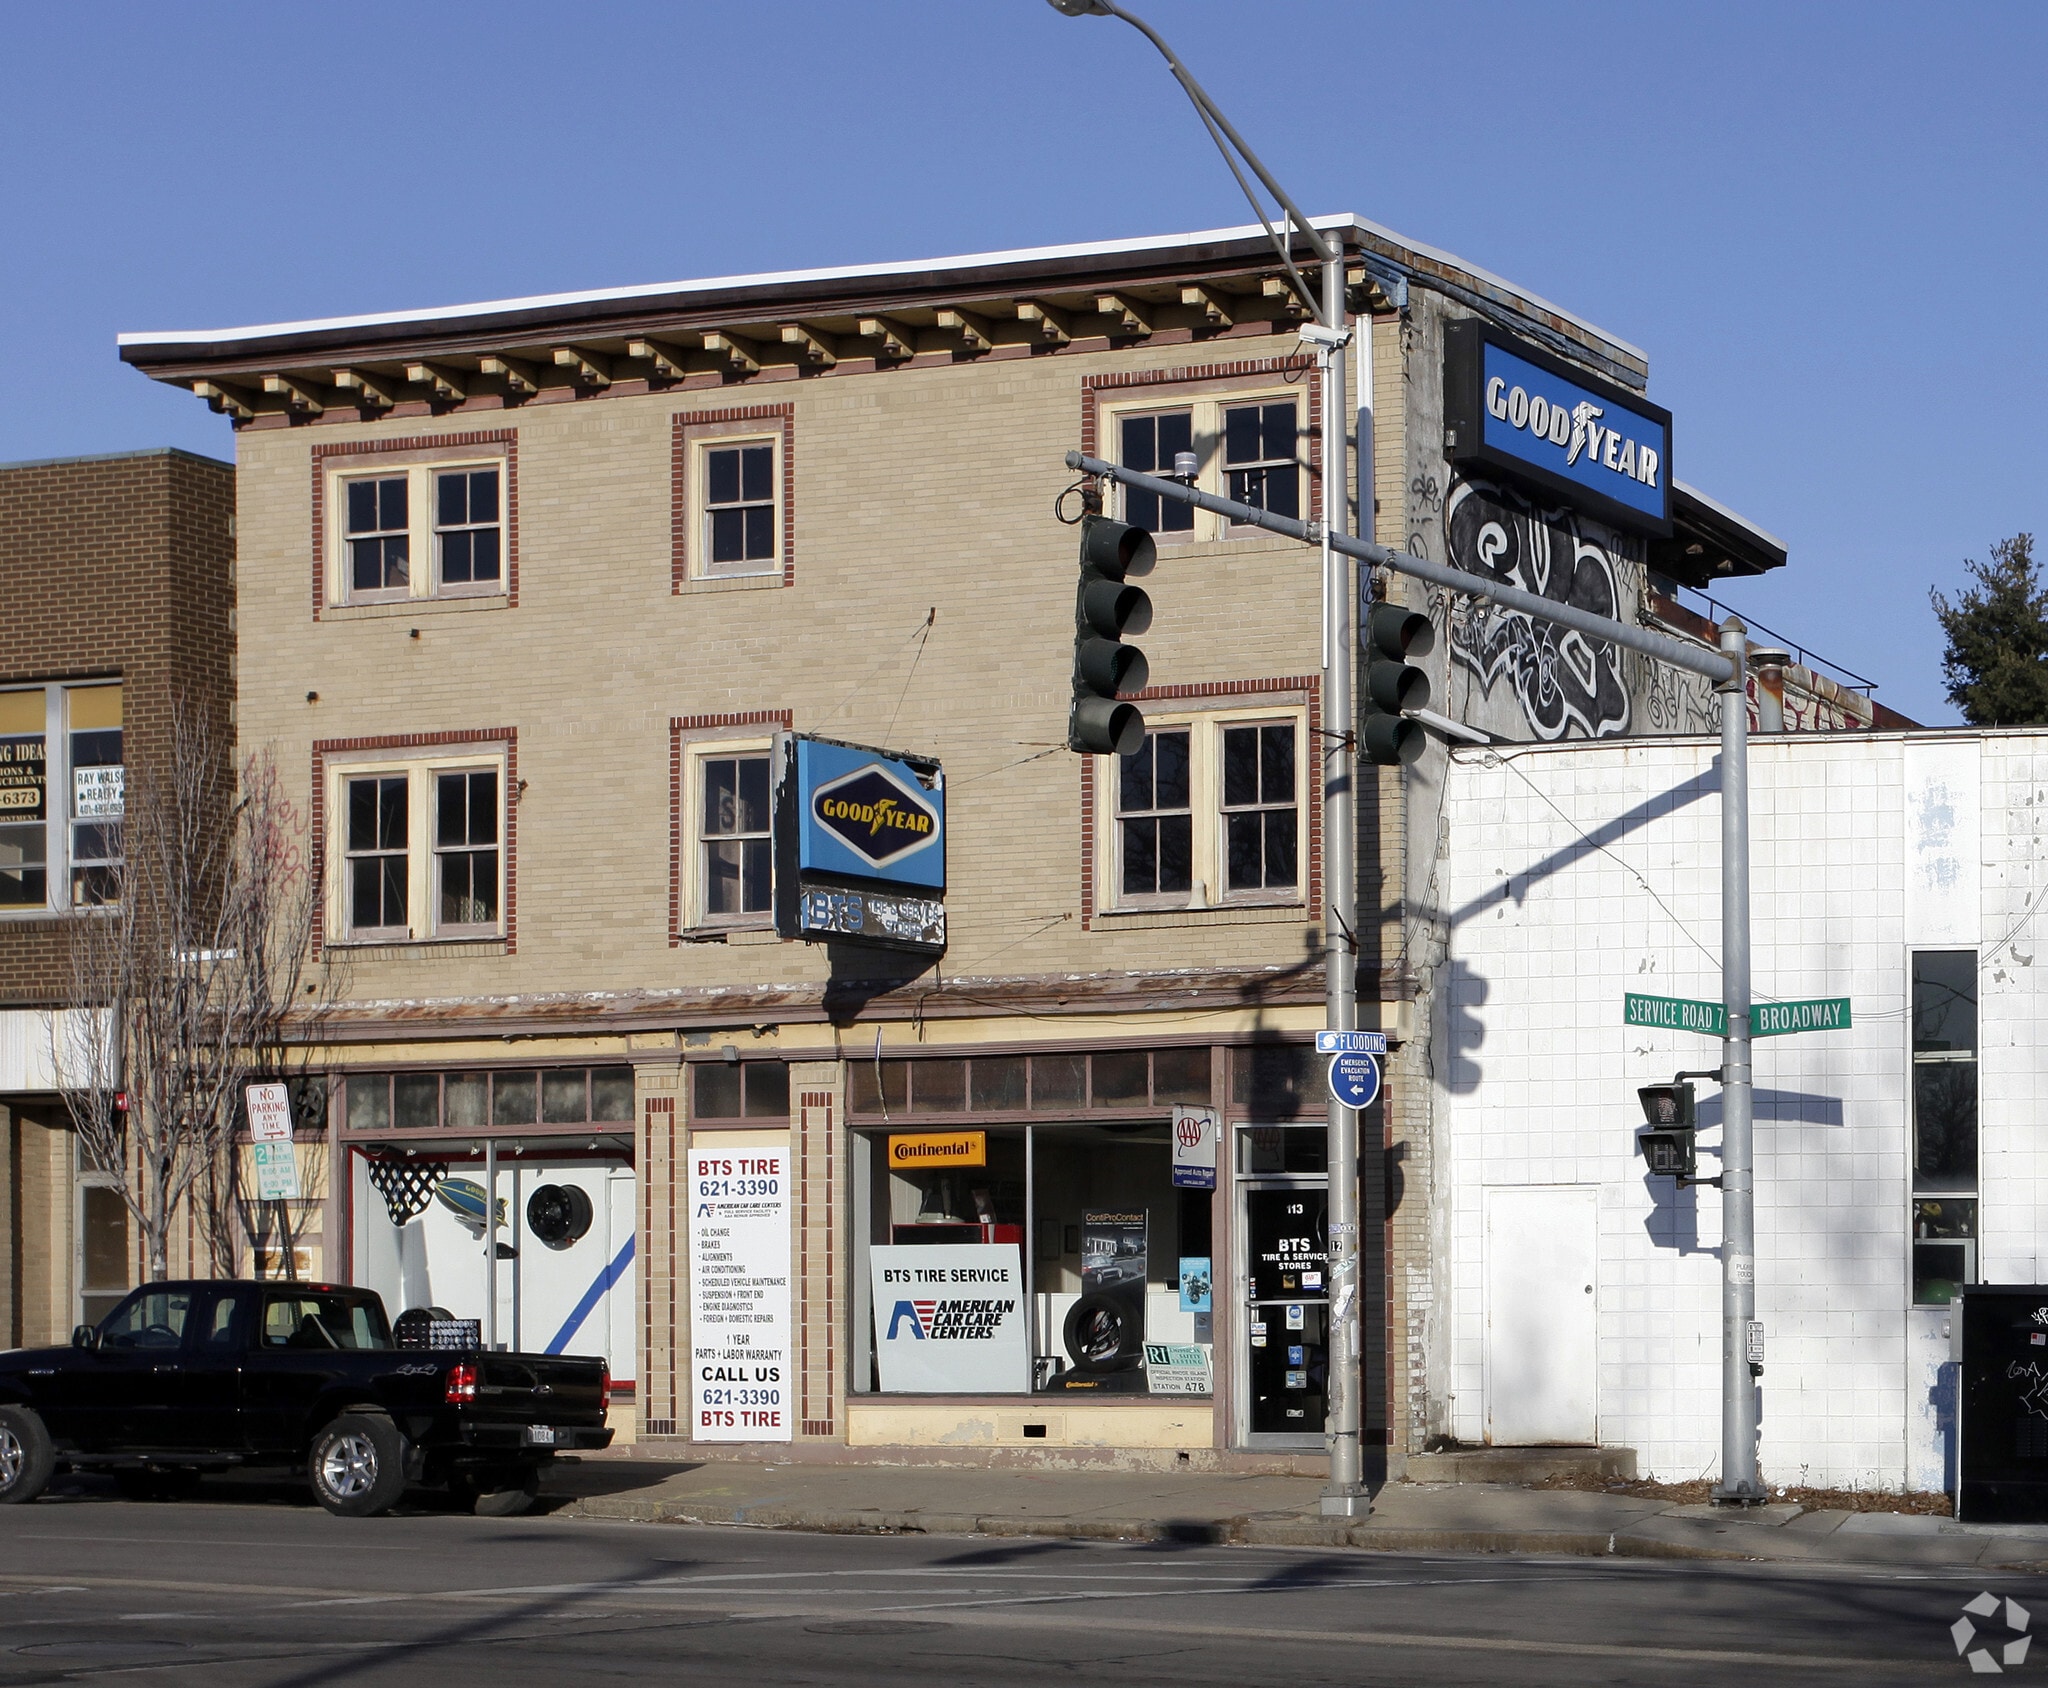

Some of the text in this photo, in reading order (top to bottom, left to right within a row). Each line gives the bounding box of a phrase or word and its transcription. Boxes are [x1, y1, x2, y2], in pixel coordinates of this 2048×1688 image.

[1487, 376, 1658, 487] GOODYEAR
[77, 773, 95, 785] RAY
[823, 799, 930, 833] GOODYEAR
[813, 892, 864, 930] BTS
[1630, 1000, 1725, 1029] SERVICE ROAD 7
[1760, 1003, 1842, 1030] BROADWAY
[1340, 1034, 1385, 1052] FLOODING
[1341, 1059, 1369, 1067] EMERGENCY
[1341, 1067, 1371, 1075] EVACUATION
[1348, 1075, 1364, 1083] ROUTE
[260, 1089, 275, 1101] NO
[251, 1102, 286, 1114] PARKING
[262, 1114, 277, 1122] ANY
[256, 1148, 267, 1162] 2
[894, 1141, 969, 1160] Continental
[698, 1159, 780, 1176] BTS TIRE
[700, 1180, 778, 1196] 621-3390
[1286, 1204, 1304, 1214] 113
[1086, 1213, 1143, 1222] ContiProContact
[701, 1228, 730, 1237] OIL CHANGE
[701, 1241, 720, 1249] BRAKES
[1278, 1238, 1311, 1252] BTS
[1332, 1241, 1342, 1251] 12
[702, 1253, 733, 1262] ALIGNMENTS
[1293, 1253, 1328, 1261] SERVICE
[702, 1265, 746, 1274] AIR CONDITIONING
[1278, 1262, 1312, 1270] STORES
[884, 1268, 1009, 1283] BTS TIRE SERVICE
[702, 1277, 786, 1287] SCHEDULED VEHICLE MAINTENANCE
[702, 1290, 732, 1299] SUSPENSION
[737, 1290, 752, 1299] FRONT
[754, 1290, 764, 1298] END
[703, 1302, 753, 1311] ENGINE DIAGNOSTICS
[937, 1299, 1015, 1313] AMERICAN
[703, 1314, 724, 1323] FOREIGN
[729, 1314, 752, 1323] DOMESTIC
[754, 1314, 774, 1323] REPAIRS
[933, 1313, 1003, 1327] CAR CARE
[931, 1326, 993, 1340] CENTERS
[727, 1334, 750, 1345] 1 YEAR
[695, 1348, 716, 1360] PARTS
[722, 1349, 744, 1360] LABOR
[746, 1350, 782, 1361] WARRANTY
[1147, 1346, 1168, 1363] RI
[397, 1364, 437, 1375] 4x4
[701, 1367, 780, 1382] CALL US
[1185, 1383, 1205, 1392] 478
[703, 1389, 780, 1405] 621-3390
[701, 1411, 781, 1427] BTS TIRE
